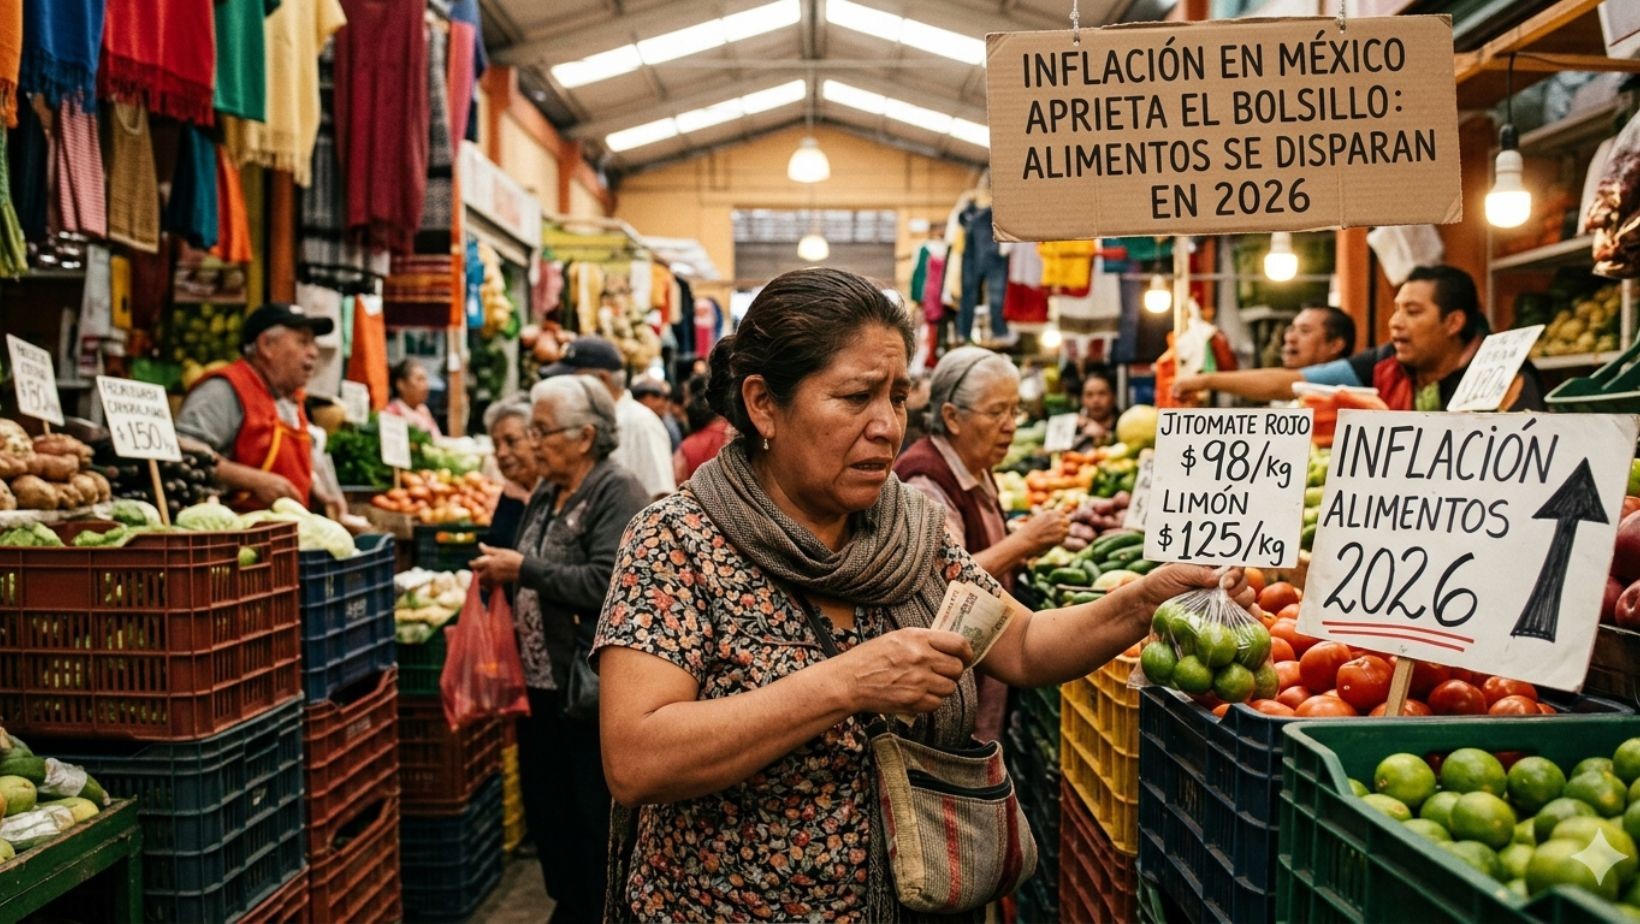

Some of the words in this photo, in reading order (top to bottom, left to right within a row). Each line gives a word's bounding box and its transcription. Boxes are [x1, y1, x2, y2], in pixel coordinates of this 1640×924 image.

[1022, 37, 1206, 89] INFLACIÓN
[1220, 43, 1264, 80] EN
[1279, 29, 1407, 77] MÉXICO
[1025, 92, 1168, 135] APRIETA
[1181, 92, 1221, 128] EL
[1233, 84, 1403, 125] BOLSILLO:
[1022, 138, 1212, 180] ALIMENTOS
[1223, 136, 1263, 171] SE
[1276, 128, 1437, 169] DISPARAN
[1151, 183, 1199, 220] EN
[1214, 177, 1312, 216] 2026
[1160, 412, 1258, 436] JITOMATE
[1264, 413, 1311, 436] ROJO
[1162, 484, 1250, 515] LIMÓN
[1323, 489, 1510, 539] ALIMENTOS
[1322, 541, 1478, 628] 2026
